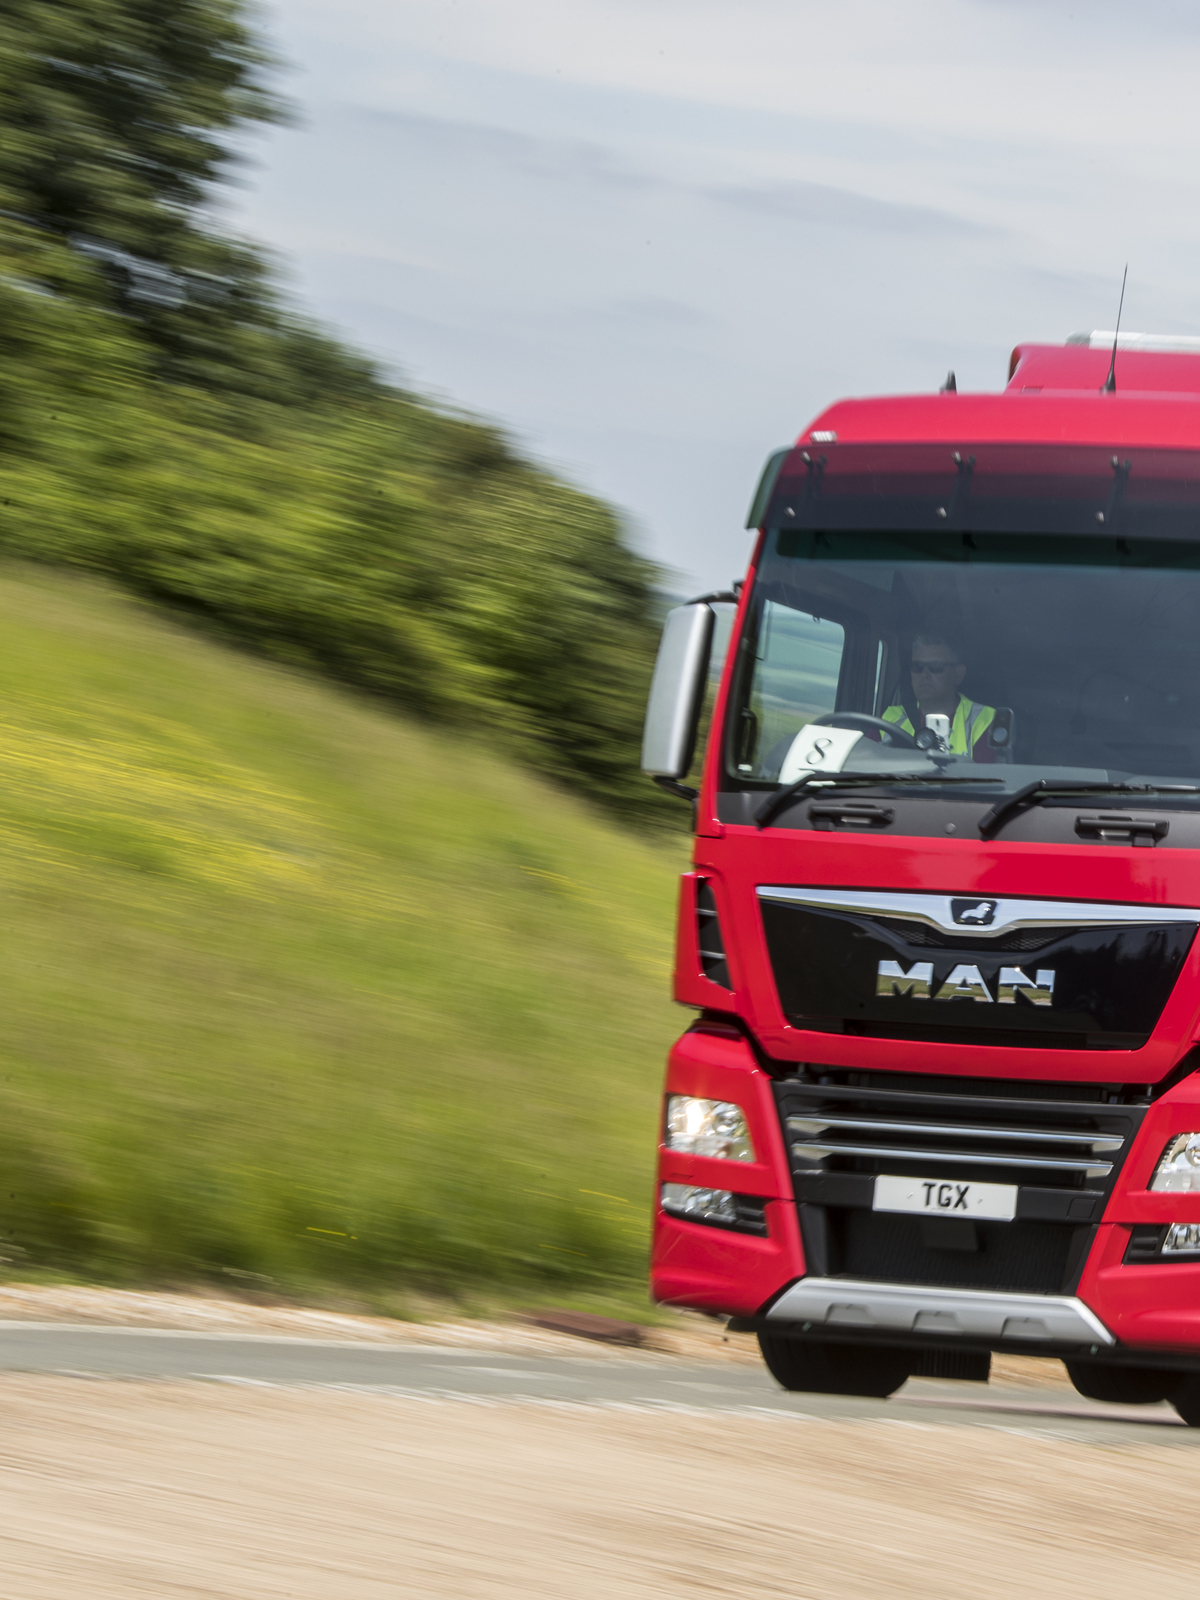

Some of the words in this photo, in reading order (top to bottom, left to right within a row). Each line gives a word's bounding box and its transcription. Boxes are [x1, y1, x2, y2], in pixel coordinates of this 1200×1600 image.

[806, 737, 832, 765] 8
[876, 960, 1055, 1006] MAN
[922, 1181, 970, 1210] TGX
